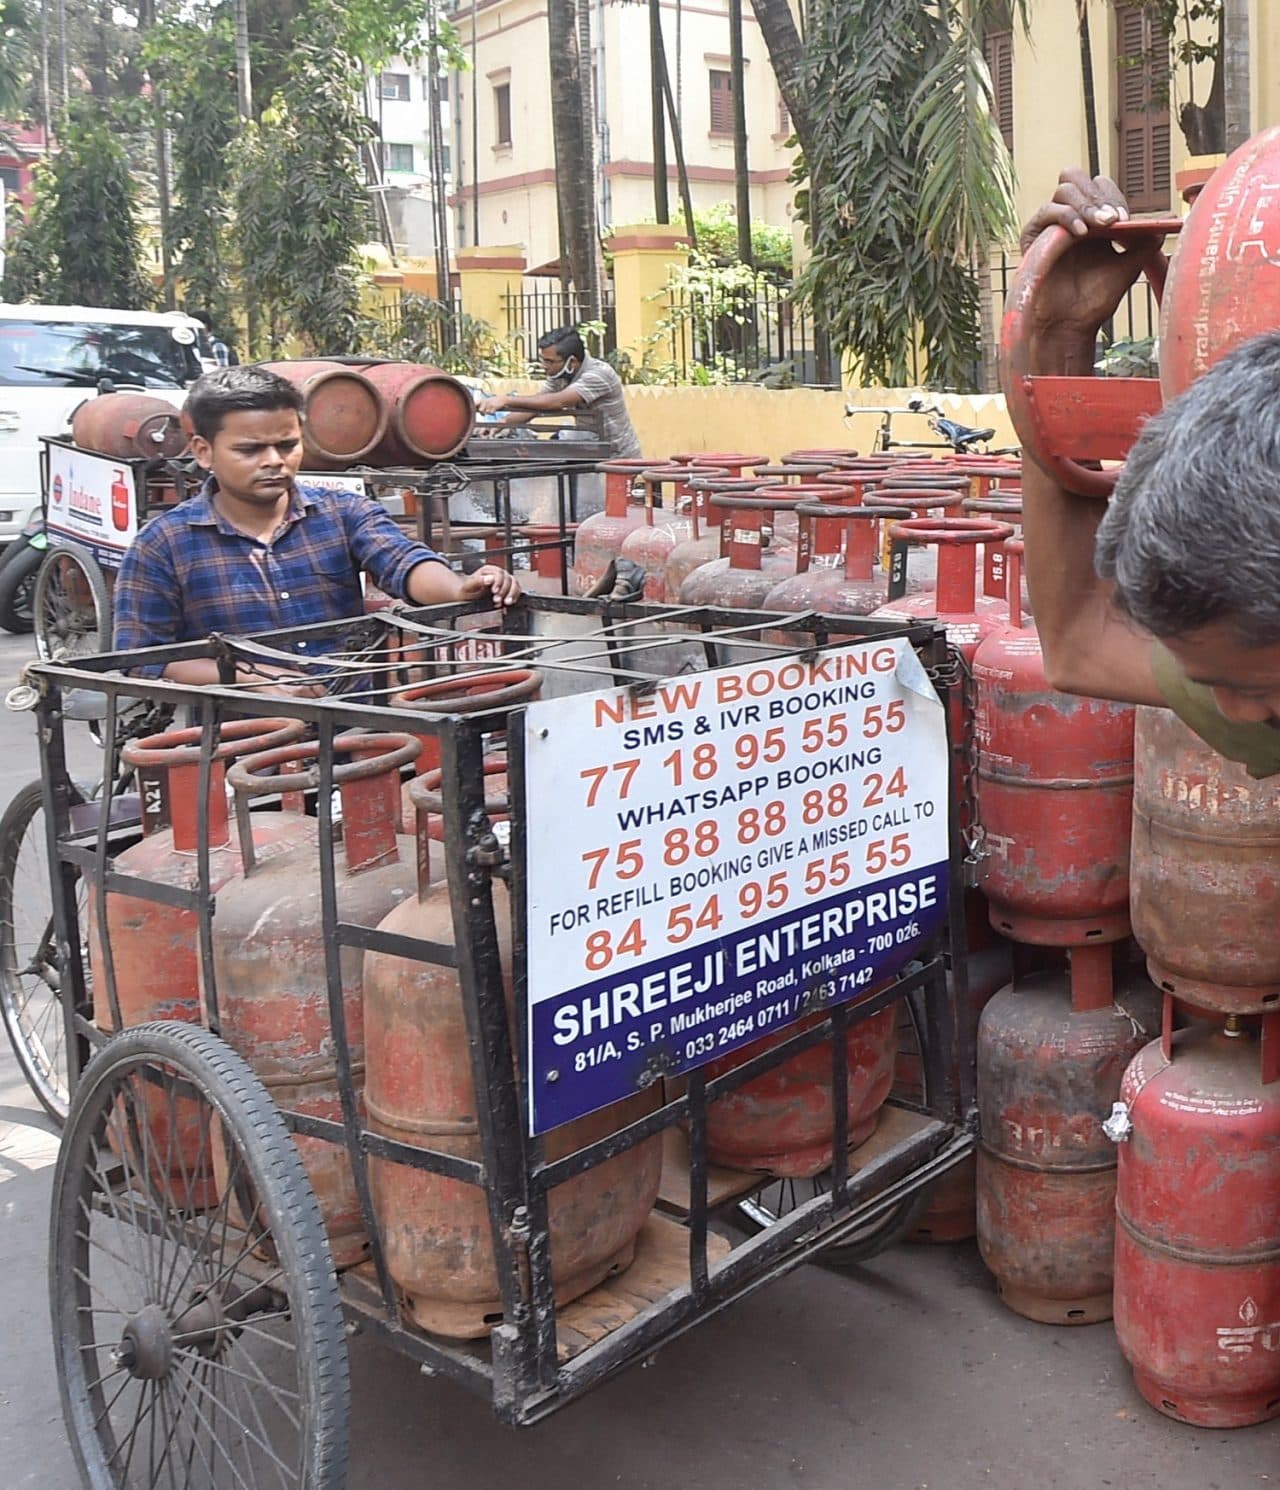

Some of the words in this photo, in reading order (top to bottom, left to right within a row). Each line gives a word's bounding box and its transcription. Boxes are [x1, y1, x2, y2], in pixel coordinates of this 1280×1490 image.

[1199, 212, 1231, 276] Mantri
[594, 681, 702, 728] NEW
[717, 647, 896, 704] BOOKING
[623, 721, 684, 750] SMS
[694, 715, 711, 736] &
[721, 705, 761, 730] IVR
[769, 682, 876, 719] BOOKING
[146, 780, 161, 813] A27
[580, 758, 641, 808] 77
[663, 743, 718, 787] 18
[735, 727, 786, 770] 95
[801, 712, 848, 754] 55
[862, 700, 906, 739] 55
[617, 776, 769, 831] WHATSAPP
[777, 747, 882, 790] BOOKING
[550, 904, 590, 936] FOR
[596, 883, 664, 920] REFILL
[670, 855, 752, 897] BOOKING
[757, 841, 794, 868] GIVE
[797, 837, 809, 857] A
[812, 819, 868, 851] MISSED
[872, 807, 911, 832] CALL
[914, 800, 935, 820] TO
[582, 838, 644, 890] 75
[663, 819, 720, 866] 88
[737, 800, 787, 845] 88
[802, 783, 848, 825] 88
[862, 766, 908, 808] 24
[585, 918, 647, 971] 84
[666, 894, 723, 944] 54
[738, 870, 789, 919] 95
[804, 851, 850, 895] 55
[865, 832, 911, 875] 55
[552, 951, 724, 1046] SHREEJI
[736, 875, 937, 977] ENTERPRISE
[574, 1040, 622, 1072] 81/A,
[627, 1031, 645, 1051] S.
[650, 1022, 665, 1042] P.
[670, 989, 752, 1035] Mukherjee
[756, 969, 798, 998] Road,
[801, 948, 856, 980] Kolkata
[867, 933, 893, 954] 700
[685, 1032, 715, 1059] 033
[718, 1015, 754, 1046] 2464
[757, 999, 789, 1027] 0711
[840, 966, 873, 993] 7142
